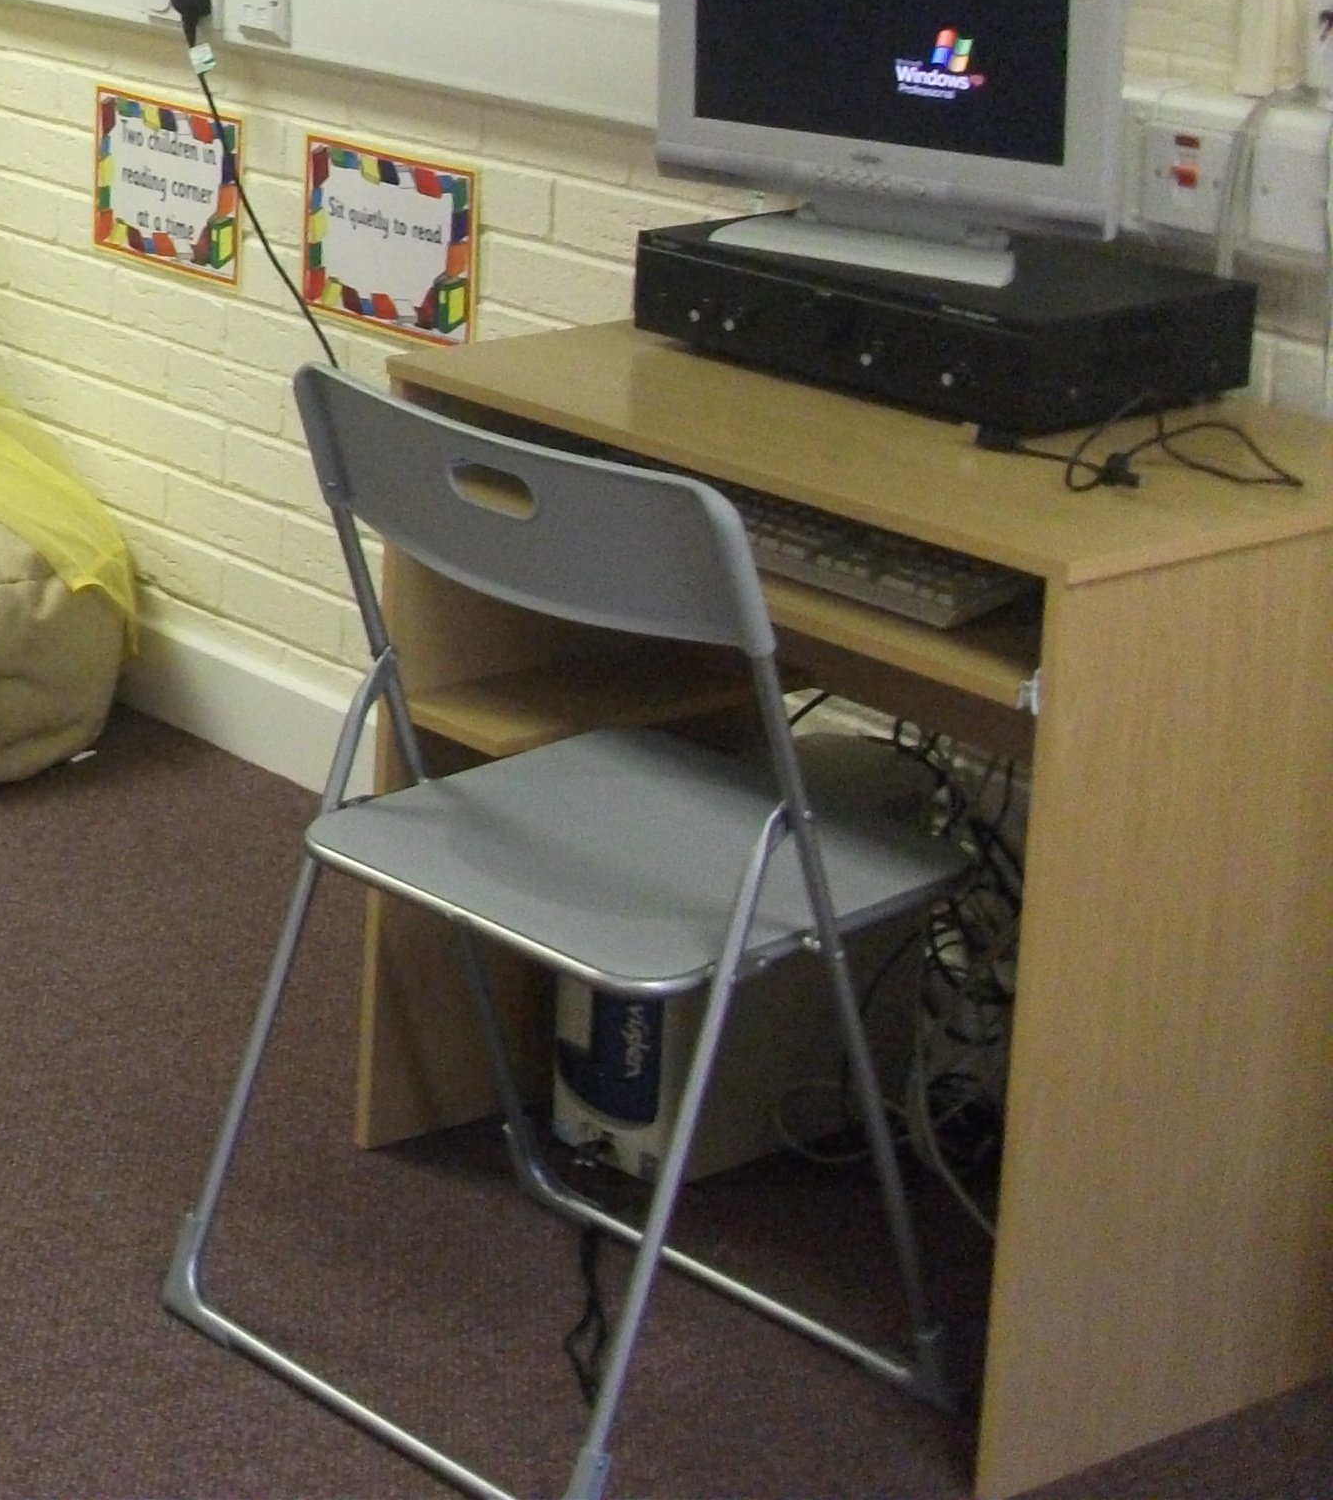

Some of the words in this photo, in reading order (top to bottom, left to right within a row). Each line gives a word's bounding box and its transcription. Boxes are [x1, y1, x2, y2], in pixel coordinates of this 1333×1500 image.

[894, 64, 971, 91] Windows
[120, 118, 145, 147] Two
[147, 127, 199, 162] children
[121, 165, 168, 202] reading
[171, 181, 213, 204] corner
[165, 214, 195, 240] time
[348, 206, 390, 239] quietly
[393, 217, 408, 236] to
[411, 224, 443, 245] read
